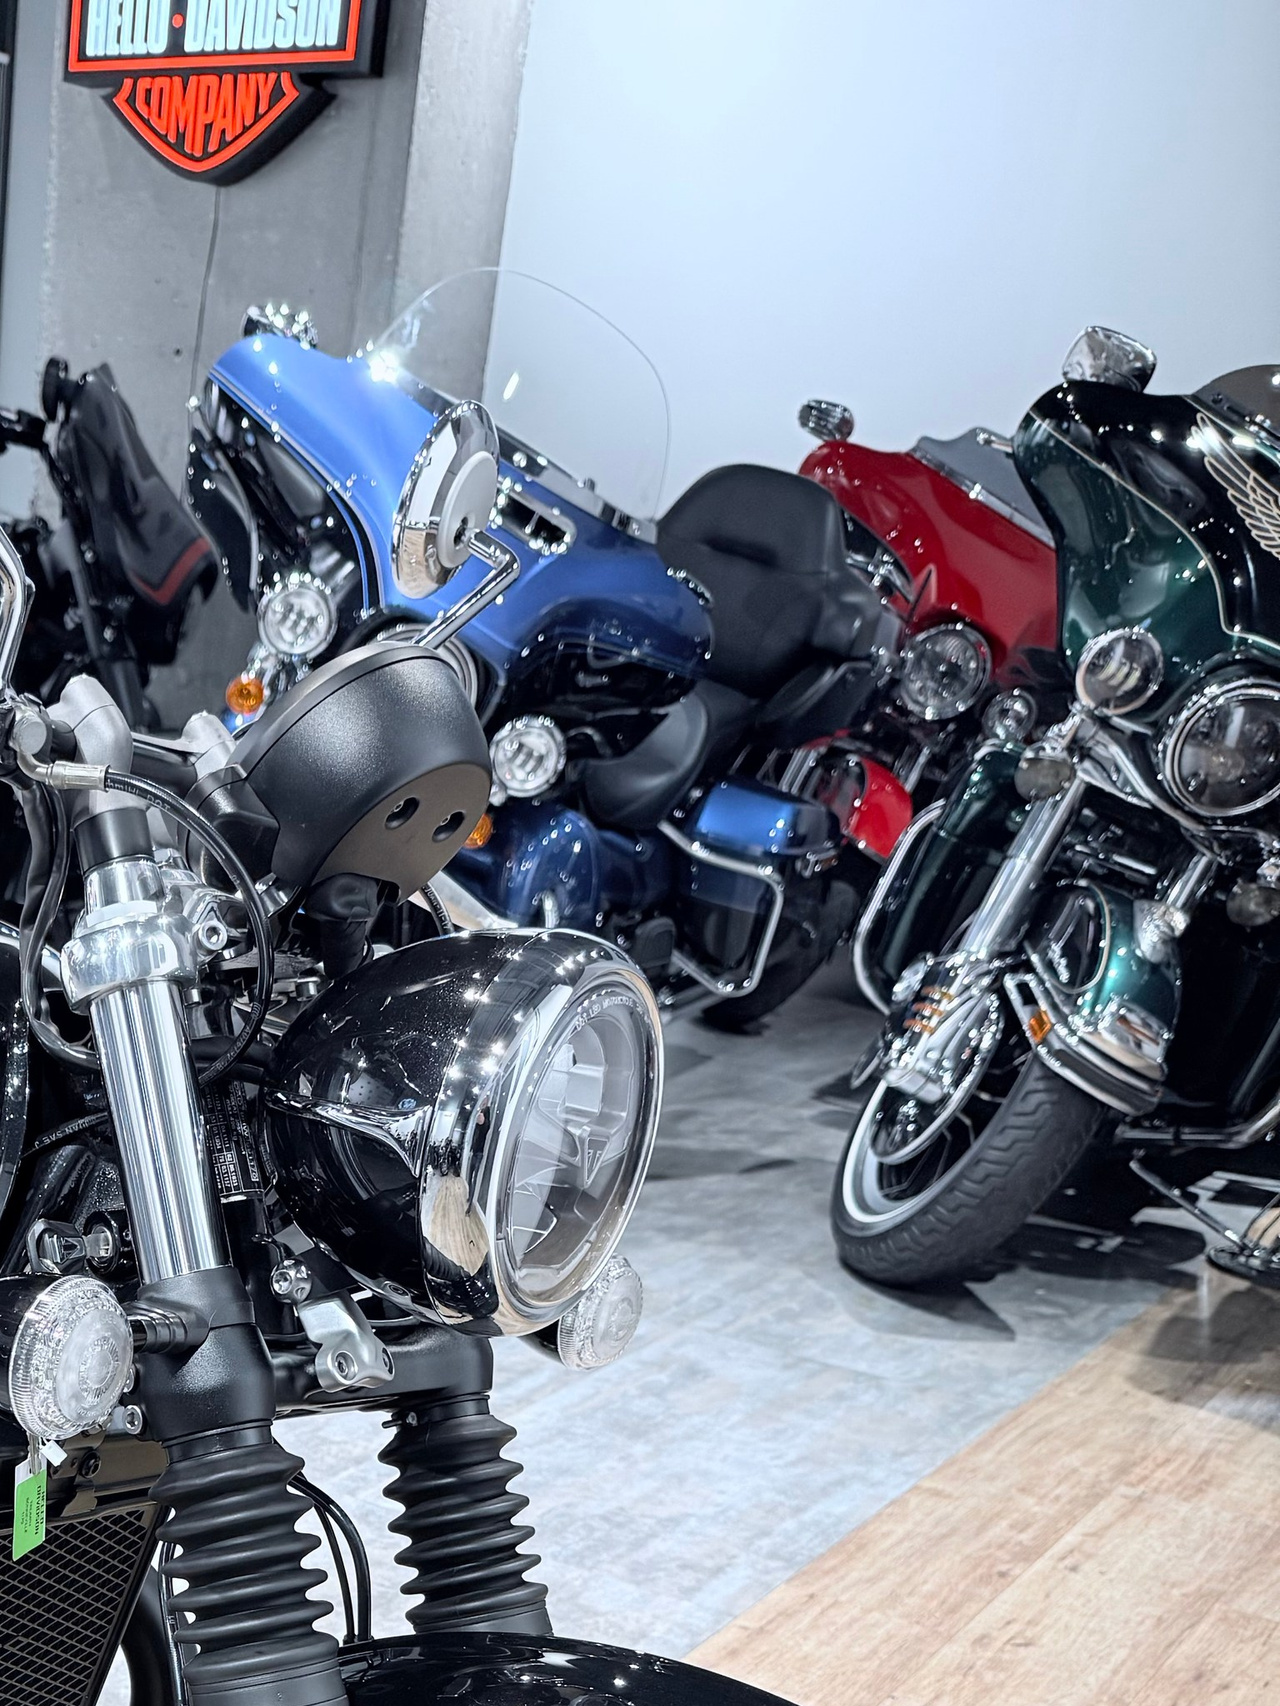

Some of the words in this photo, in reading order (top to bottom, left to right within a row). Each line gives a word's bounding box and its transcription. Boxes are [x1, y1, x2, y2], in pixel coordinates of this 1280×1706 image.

[85, 0, 171, 56] HELLO
[183, 0, 342, 53] DAVIDSON
[135, 72, 279, 157] COMPANY
